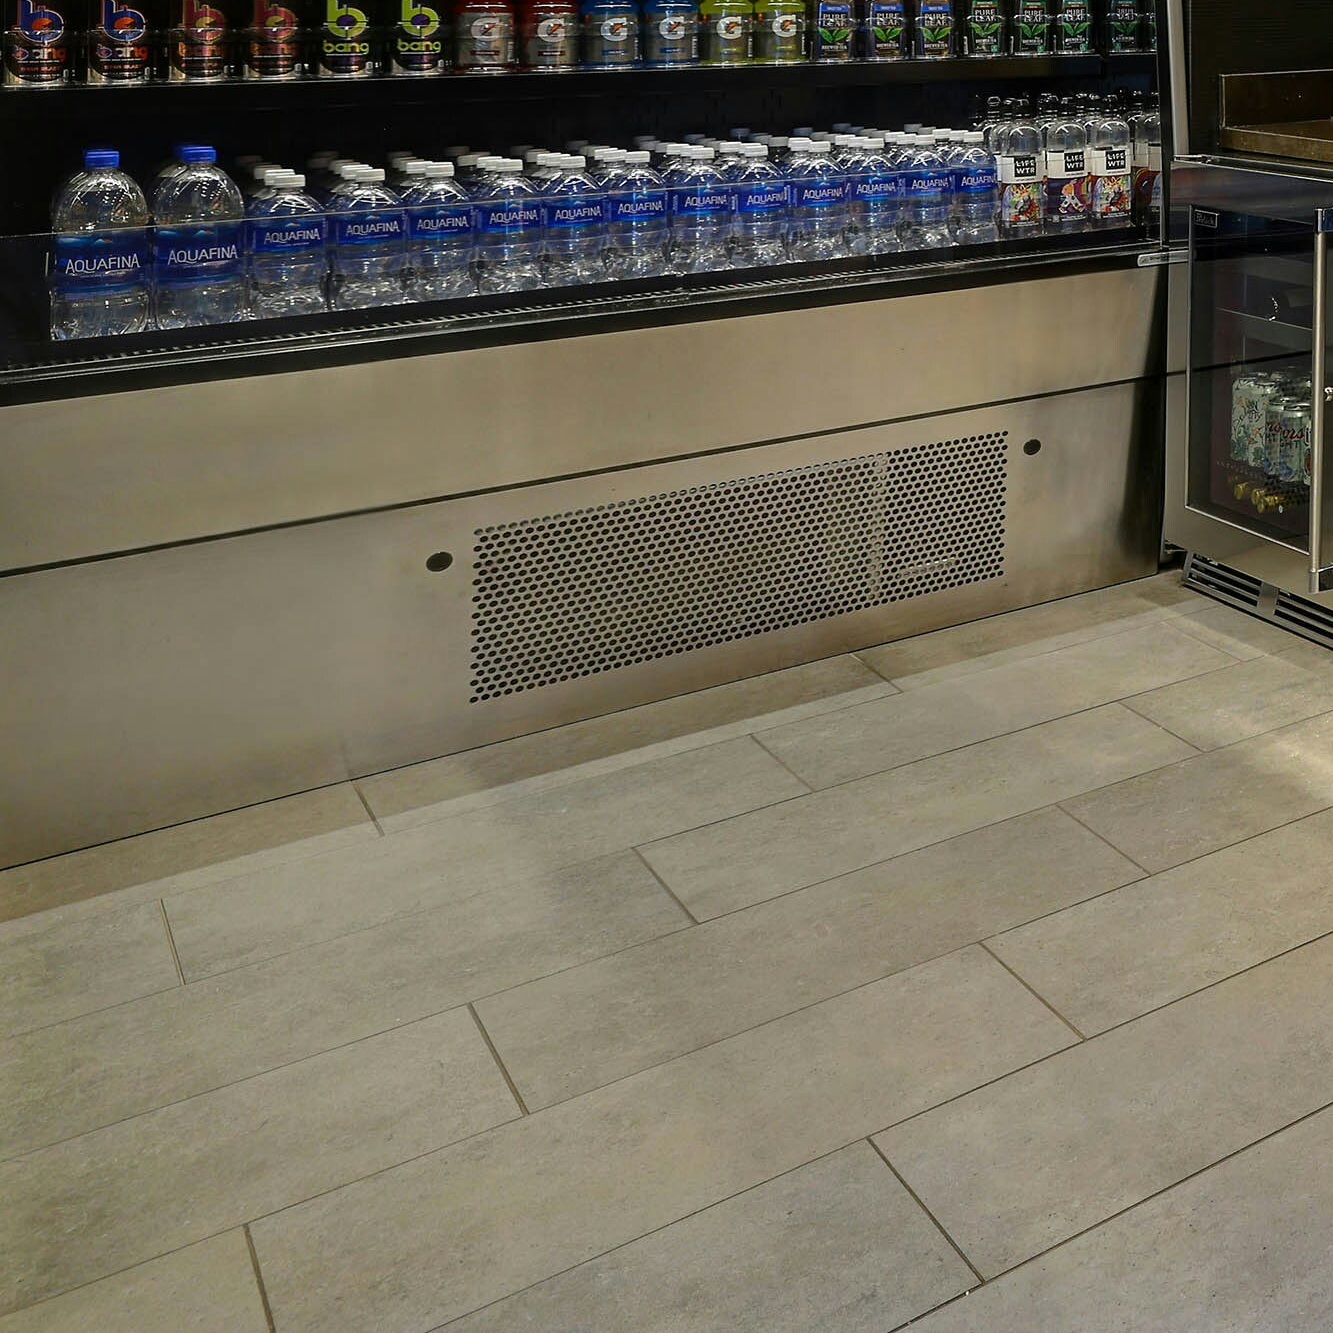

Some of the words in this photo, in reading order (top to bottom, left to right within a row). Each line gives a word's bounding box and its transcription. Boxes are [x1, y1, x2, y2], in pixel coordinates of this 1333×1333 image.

[323, 40, 369, 54] bang
[397, 39, 441, 52] bang
[1065, 161, 1084, 170] WTR
[1106, 159, 1125, 168] WTR
[1015, 167, 1035, 176] WTR
[617, 199, 663, 215] AQUAFINA
[416, 216, 469, 231] AQUAFINA
[489, 209, 539, 224] AQUAFINA
[264, 227, 320, 244] AQUAFINA
[346, 220, 400, 236] AQUAFINA
[168, 244, 238, 265] AQUAFINA
[65, 253, 140, 273] AQUAFINA
